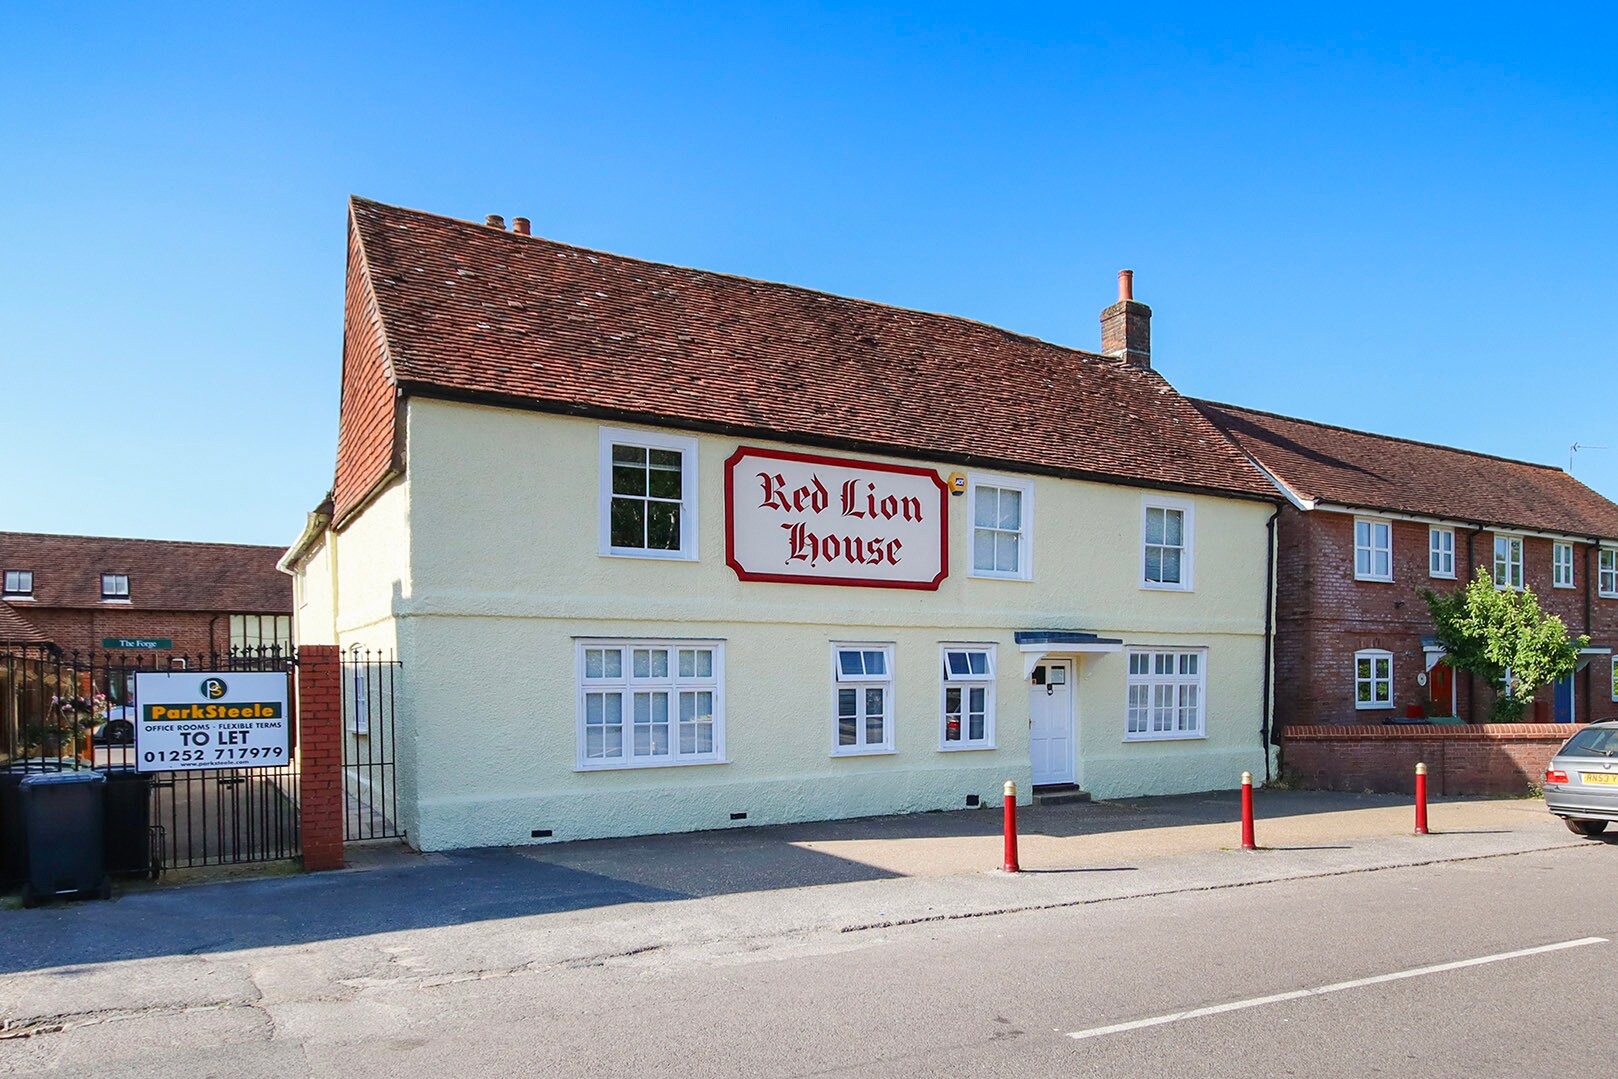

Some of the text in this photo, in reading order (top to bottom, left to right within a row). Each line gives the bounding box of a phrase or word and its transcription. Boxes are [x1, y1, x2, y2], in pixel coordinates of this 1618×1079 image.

[755, 472, 923, 523] Red Lion
[780, 521, 903, 568] House
[119, 639, 157, 649] The Forge
[151, 703, 274, 720] ParkSteele
[177, 723, 210, 731] ROOMS
[218, 722, 253, 730] FLEXIBLE
[256, 721, 282, 729] TERMS
[180, 730, 250, 746] TO LET
[144, 746, 283, 763] 01252 717979
